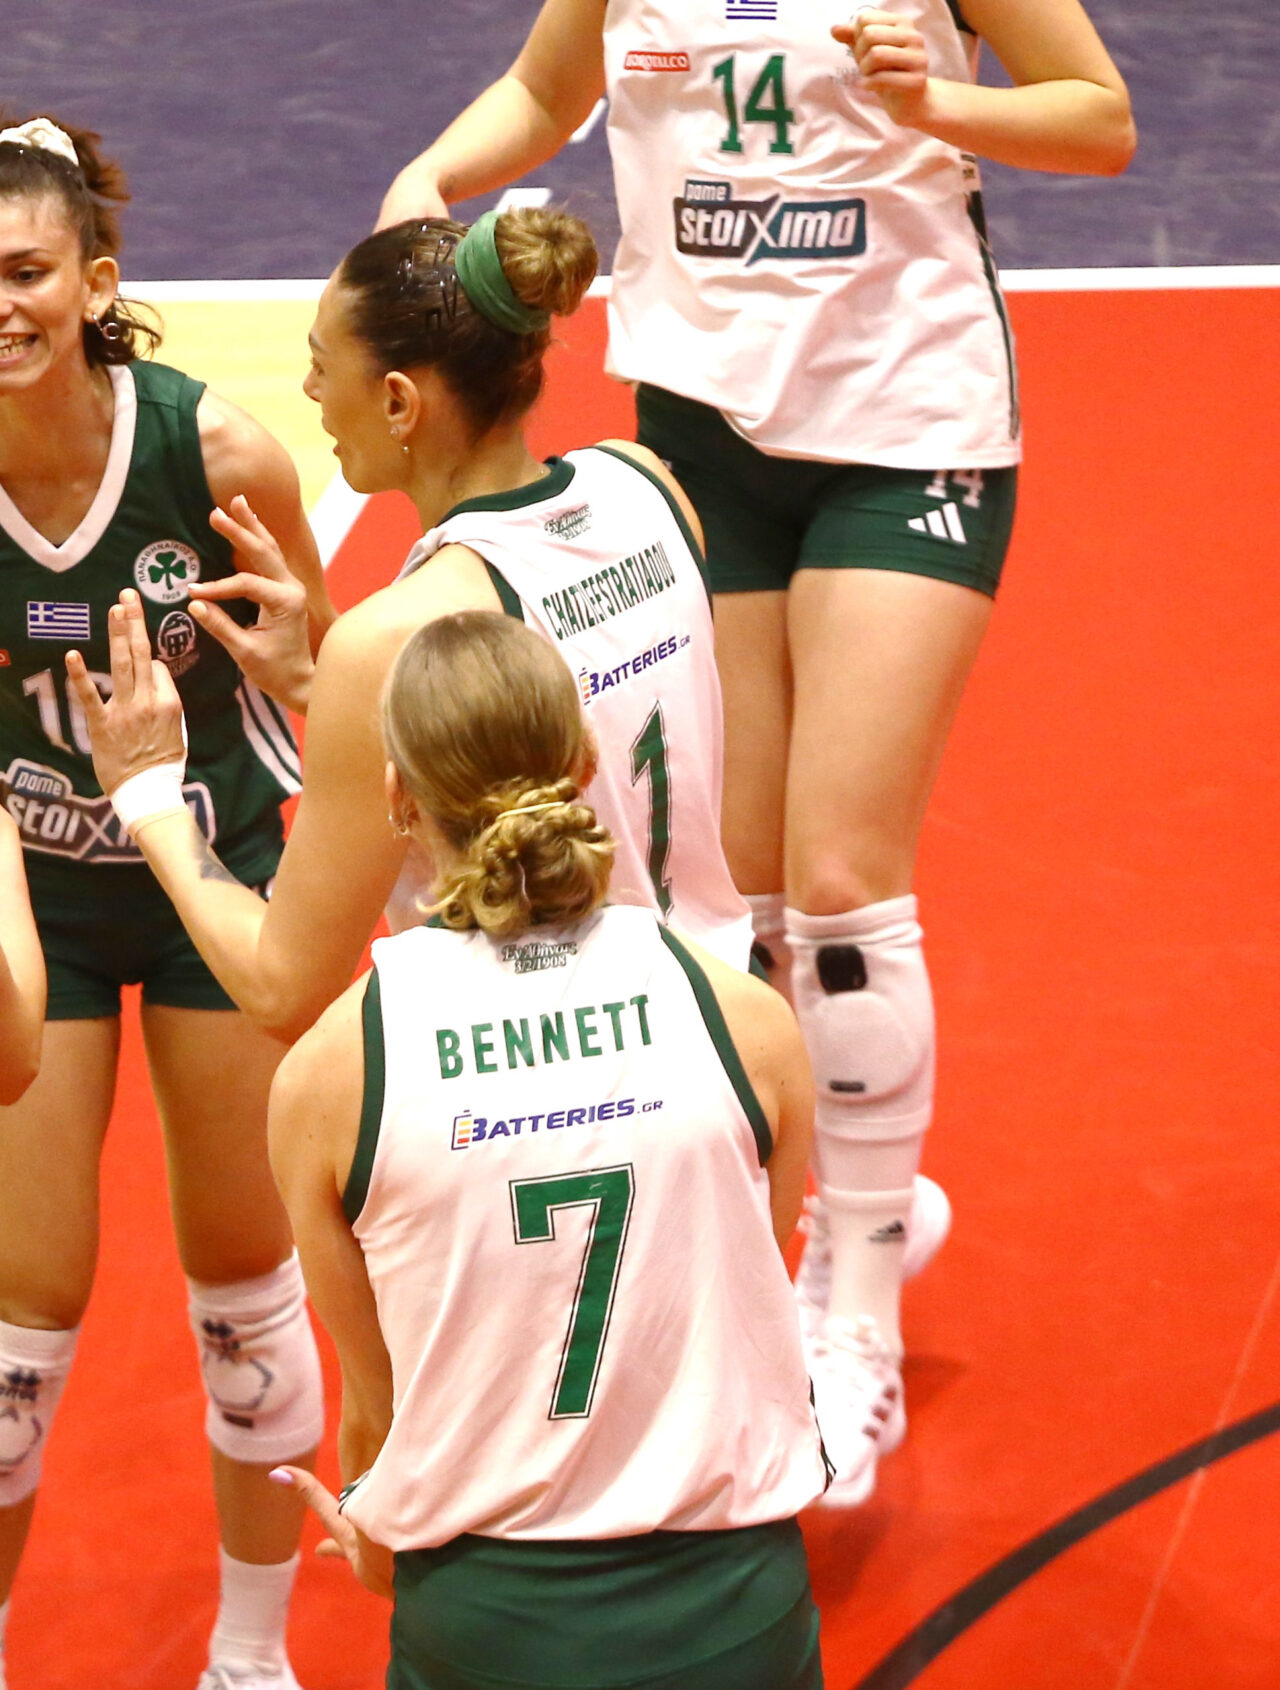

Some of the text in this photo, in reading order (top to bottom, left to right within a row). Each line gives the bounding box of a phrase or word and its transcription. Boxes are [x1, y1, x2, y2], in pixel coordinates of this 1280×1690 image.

[712, 52, 795, 157] 14
[924, 470, 984, 509] 14
[15, 770, 63, 797] pame
[630, 699, 675, 926] 1
[514, 953, 567, 974] 3/2/1908
[436, 994, 652, 1080] BENNETT
[508, 1162, 636, 1421] 7
